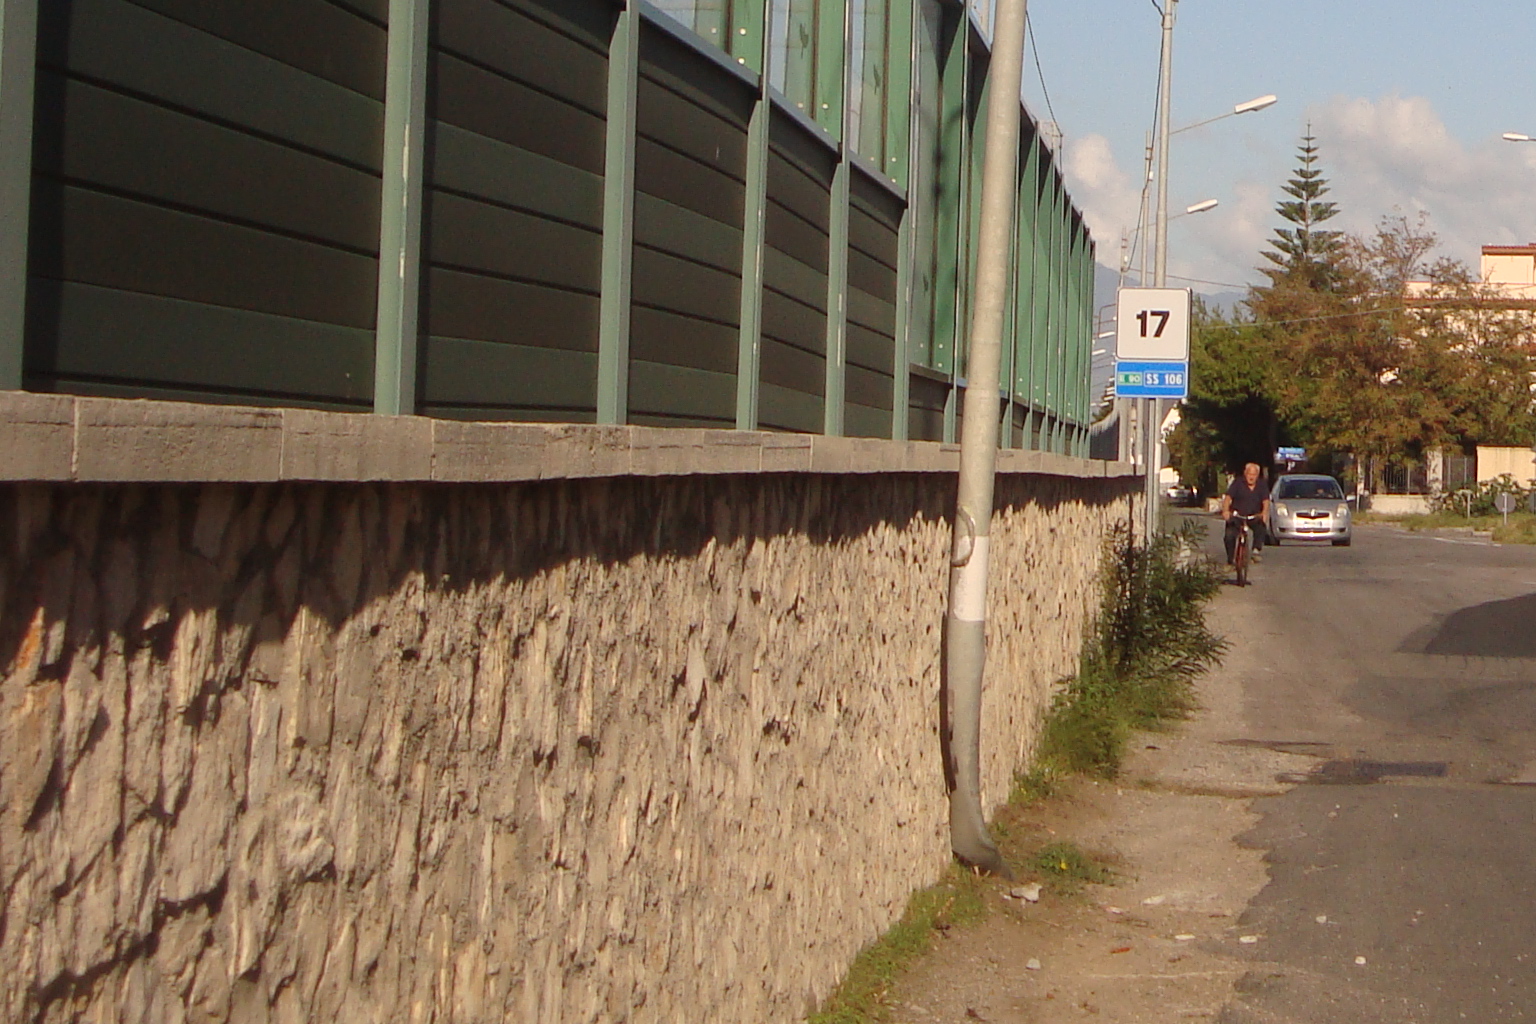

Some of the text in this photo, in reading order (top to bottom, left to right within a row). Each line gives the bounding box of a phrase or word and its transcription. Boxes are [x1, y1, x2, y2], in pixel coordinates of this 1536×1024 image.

[1135, 310, 1171, 338] 17
[1145, 373, 1183, 385] SS 106
